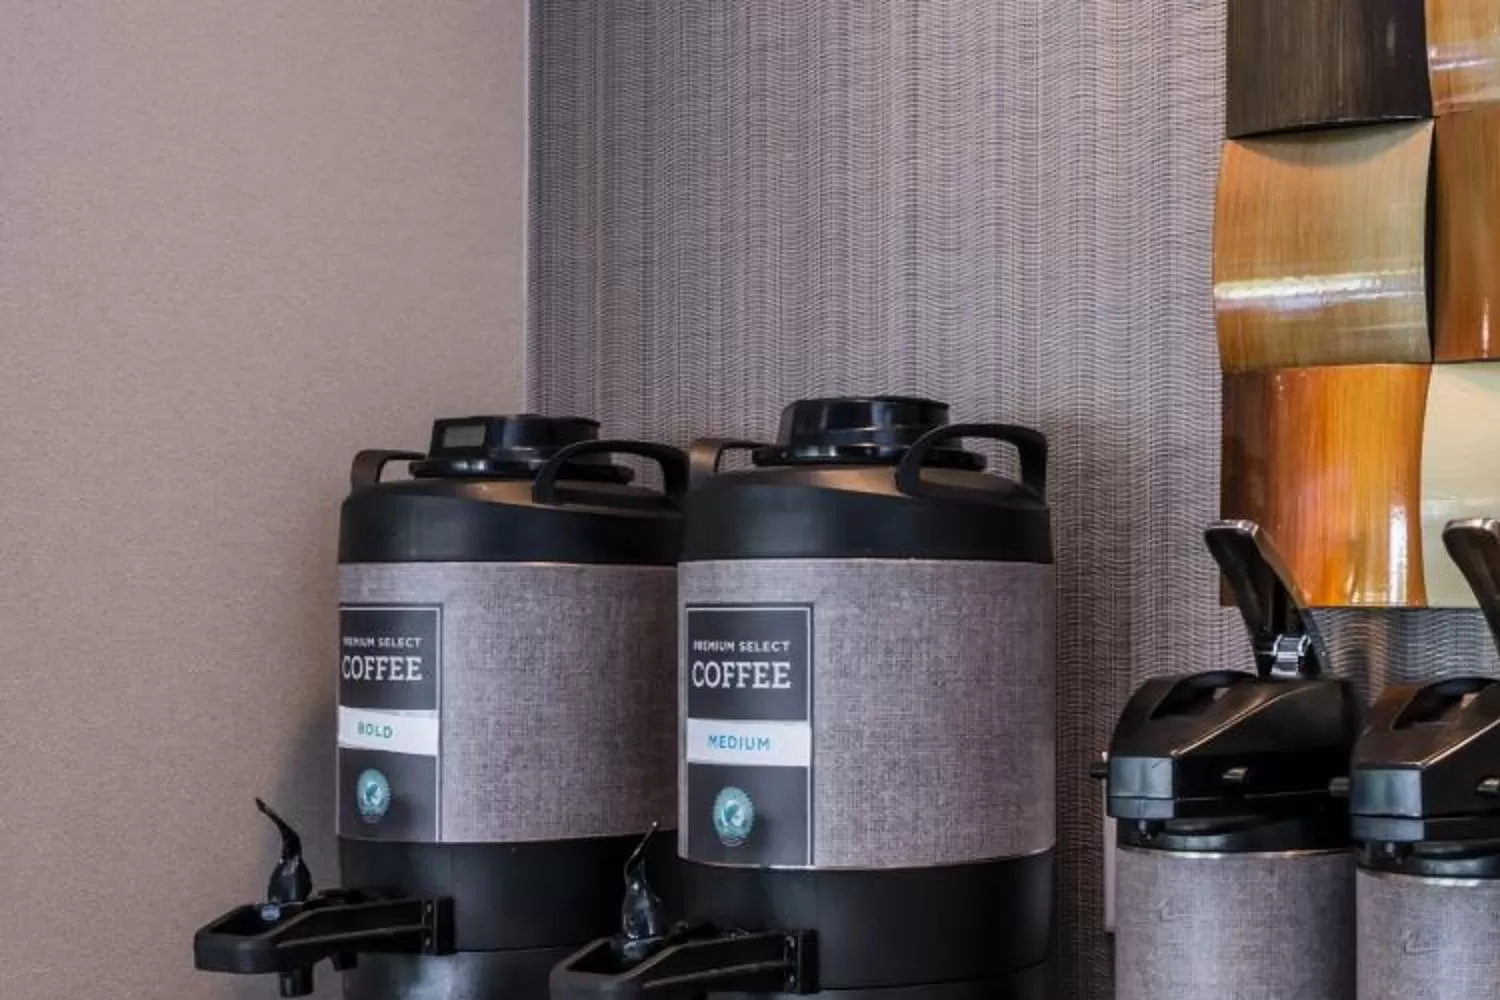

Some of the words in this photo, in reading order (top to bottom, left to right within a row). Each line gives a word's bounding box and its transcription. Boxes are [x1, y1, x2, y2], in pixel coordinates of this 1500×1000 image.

[379, 637, 422, 649] SELECT
[693, 640, 735, 652] PREMIUM
[739, 641, 791, 653] SELECT
[342, 656, 422, 681] COFFEE
[691, 661, 792, 689] COFFEE
[357, 721, 393, 739] BOLD
[707, 734, 771, 751] MEDIUM
